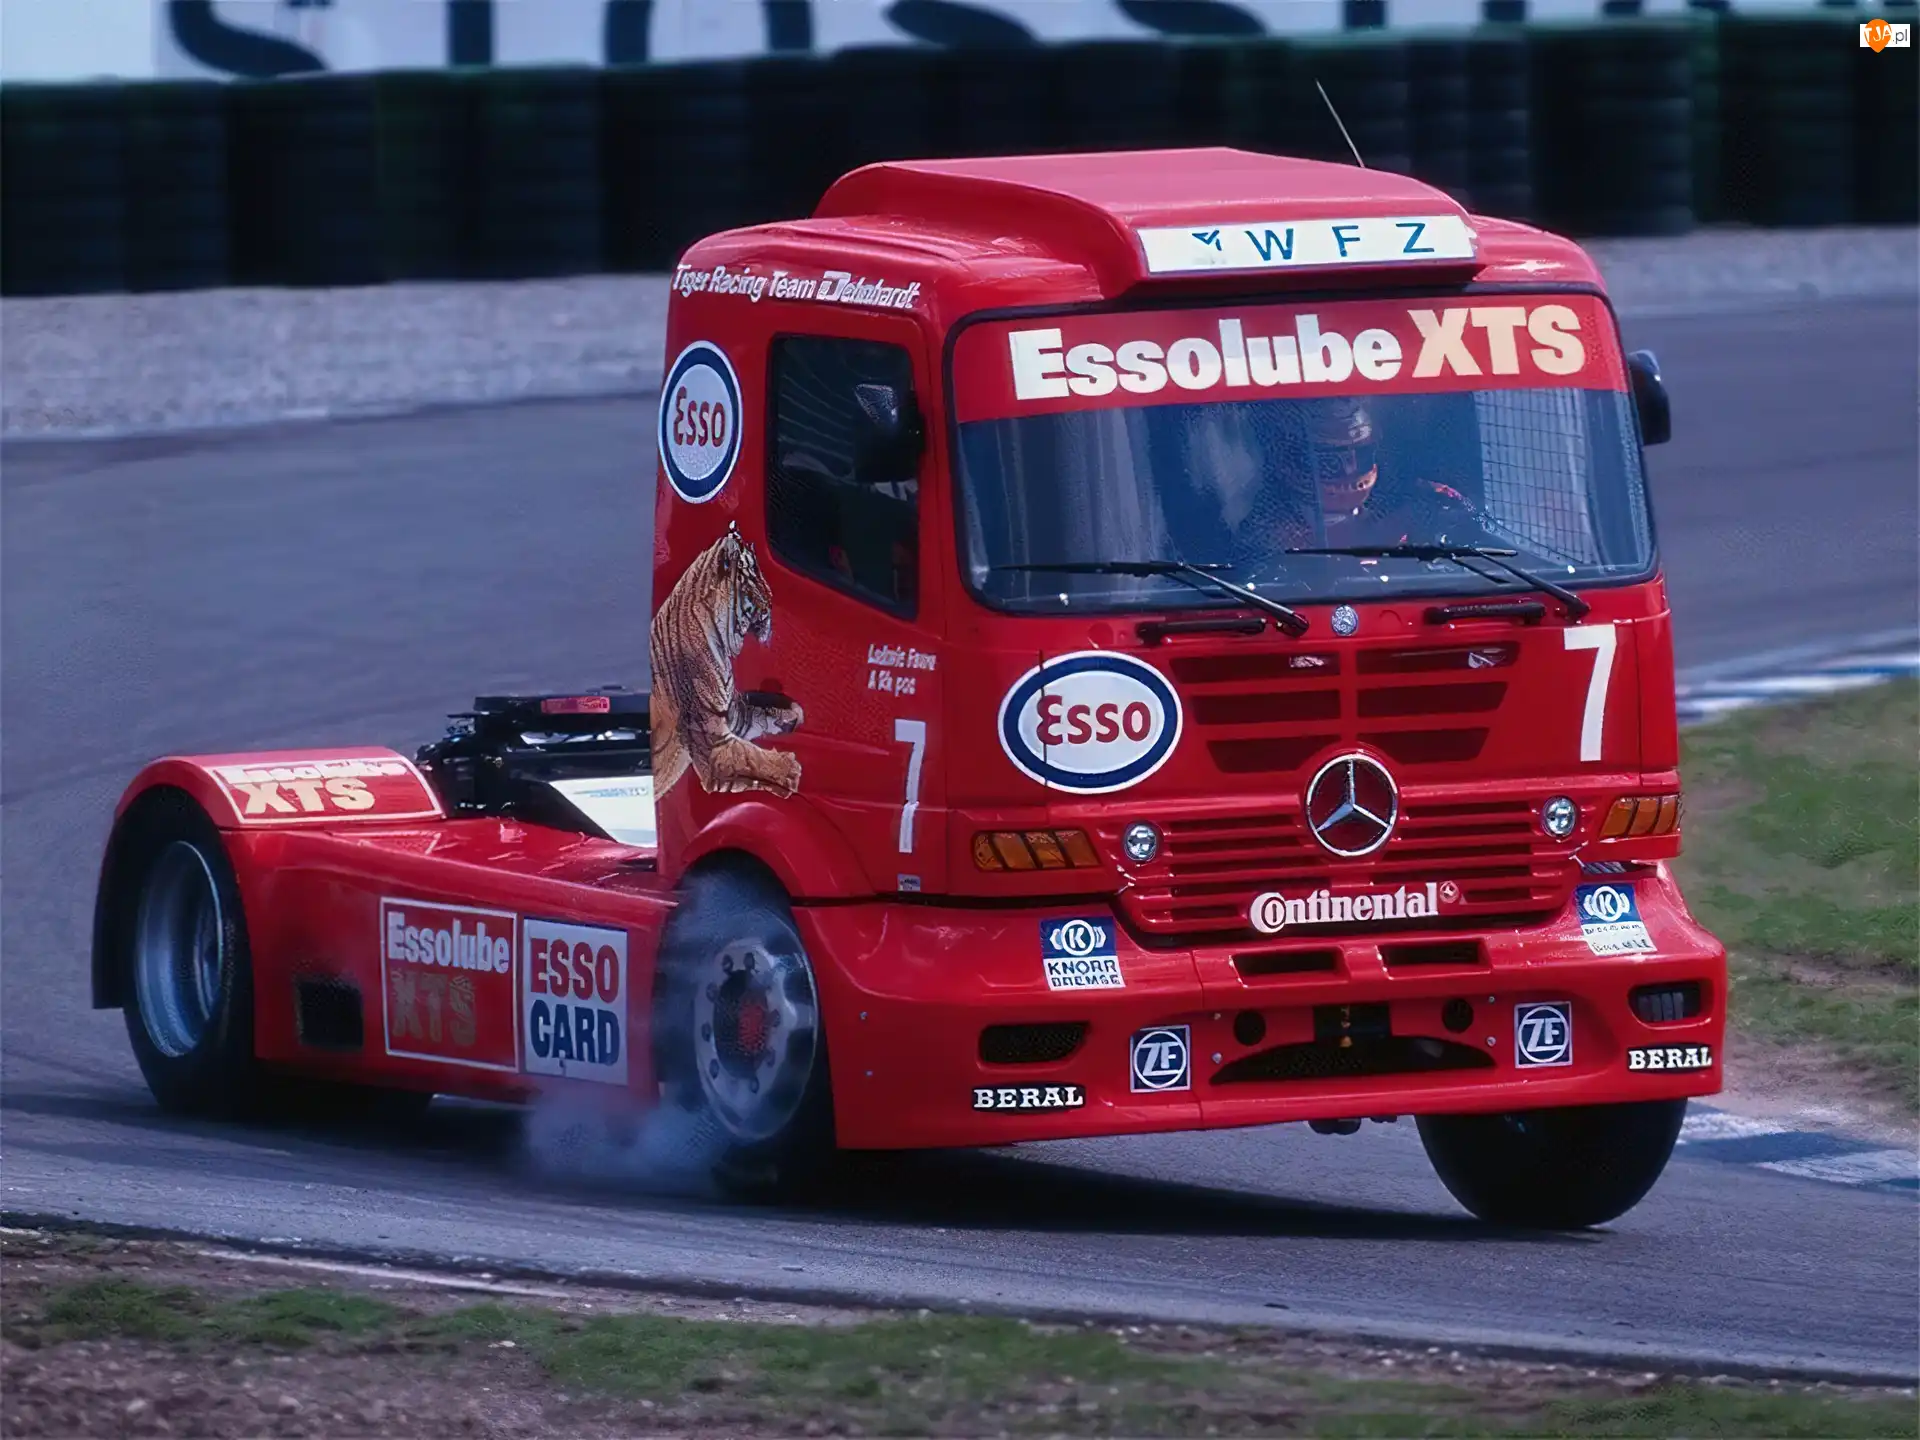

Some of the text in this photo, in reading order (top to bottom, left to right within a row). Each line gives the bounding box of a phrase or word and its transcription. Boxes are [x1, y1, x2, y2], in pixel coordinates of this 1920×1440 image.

[673, 264, 711, 297] Tiger
[707, 265, 768, 302] Racing
[768, 270, 818, 299] Team
[1009, 304, 1586, 400] Essolube XTS
[1563, 623, 1617, 762] 7
[234, 777, 375, 814] XTS
[894, 719, 926, 853] 7
[1250, 882, 1439, 933] Continental
[388, 912, 510, 974] Essolube
[531, 938, 620, 1003] ESSO
[1047, 960, 1117, 975] KNORR
[530, 999, 621, 1067] CARD
[1518, 1015, 1564, 1054] ZF
[1137, 1041, 1182, 1077] ZF
[1628, 1047, 1713, 1070] BERAL
[973, 1086, 1084, 1108] BERAL
